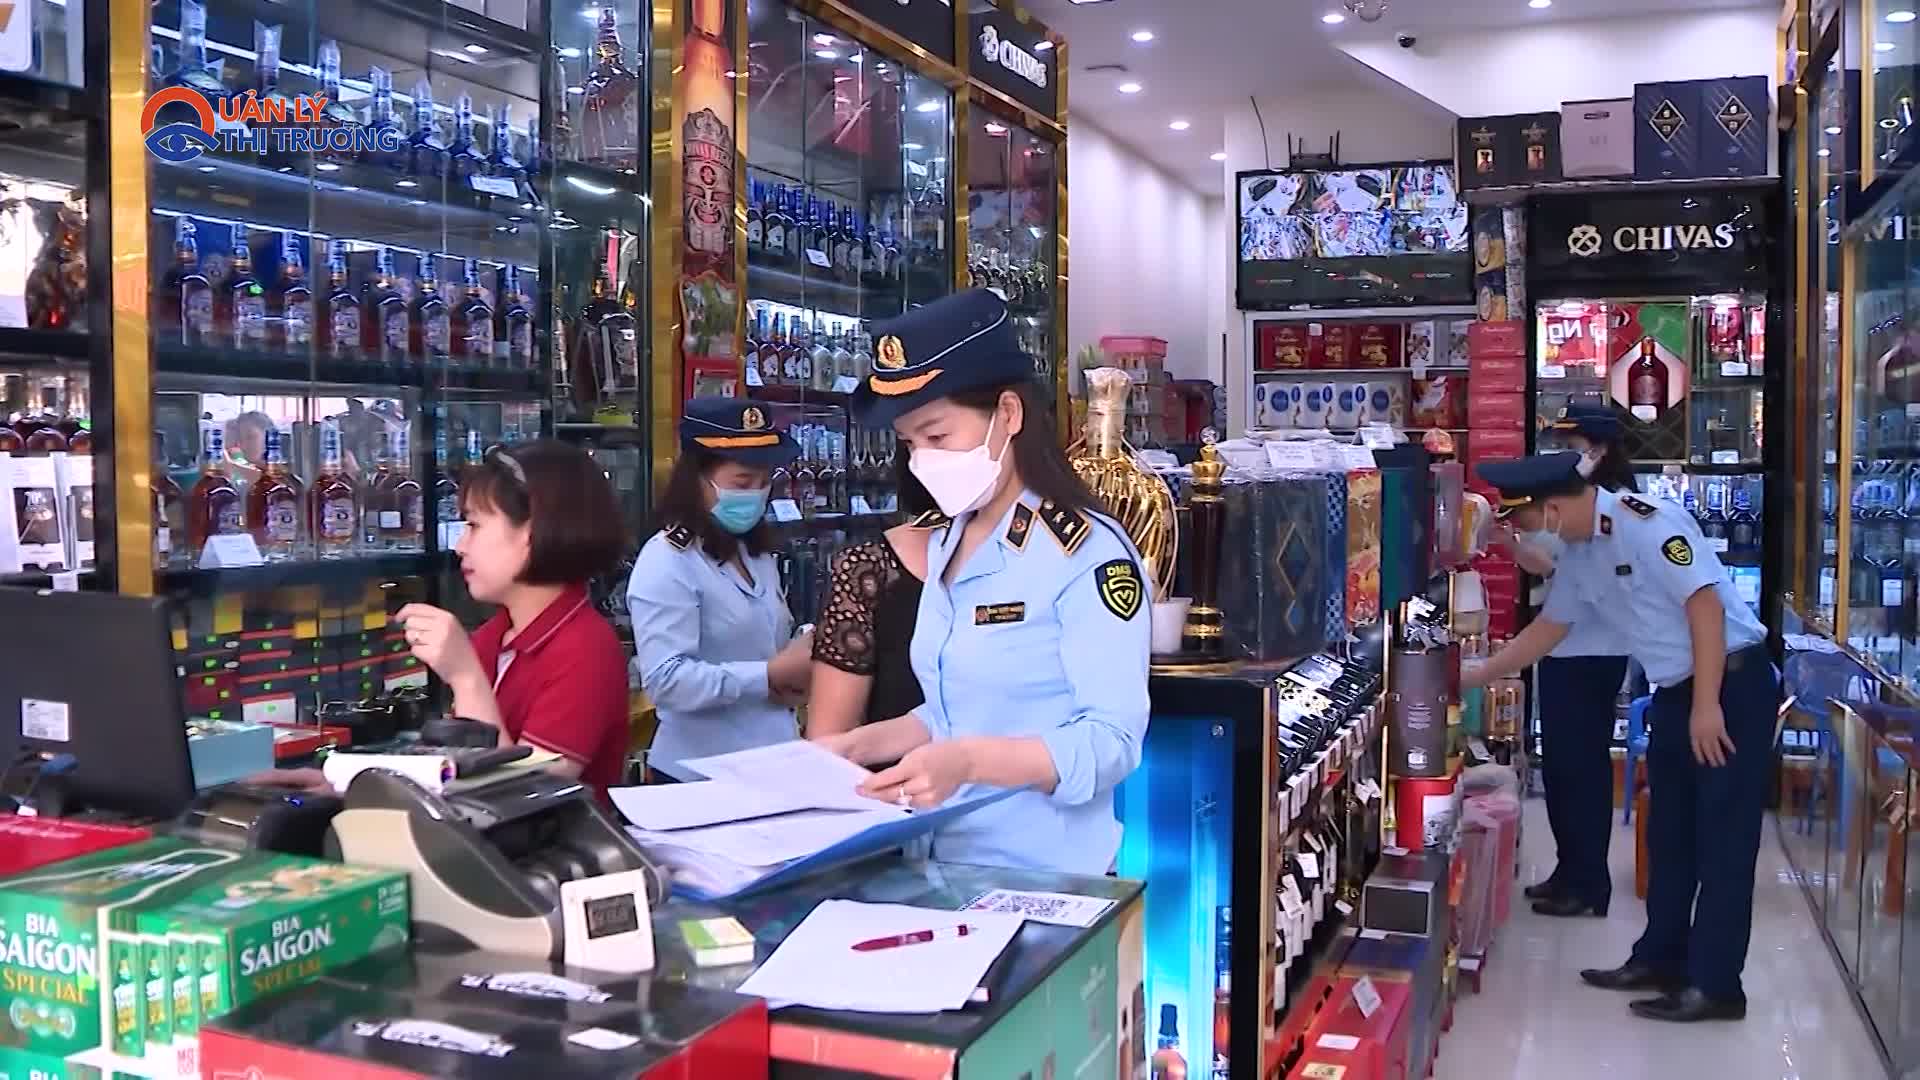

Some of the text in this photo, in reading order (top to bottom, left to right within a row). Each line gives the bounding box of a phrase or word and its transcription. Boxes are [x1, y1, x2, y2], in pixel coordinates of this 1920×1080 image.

[1613, 223, 1736, 253] CHIVAS
[25, 913, 58, 938] BIA
[272, 915, 300, 938] BIA
[240, 921, 334, 976] SAIGON
